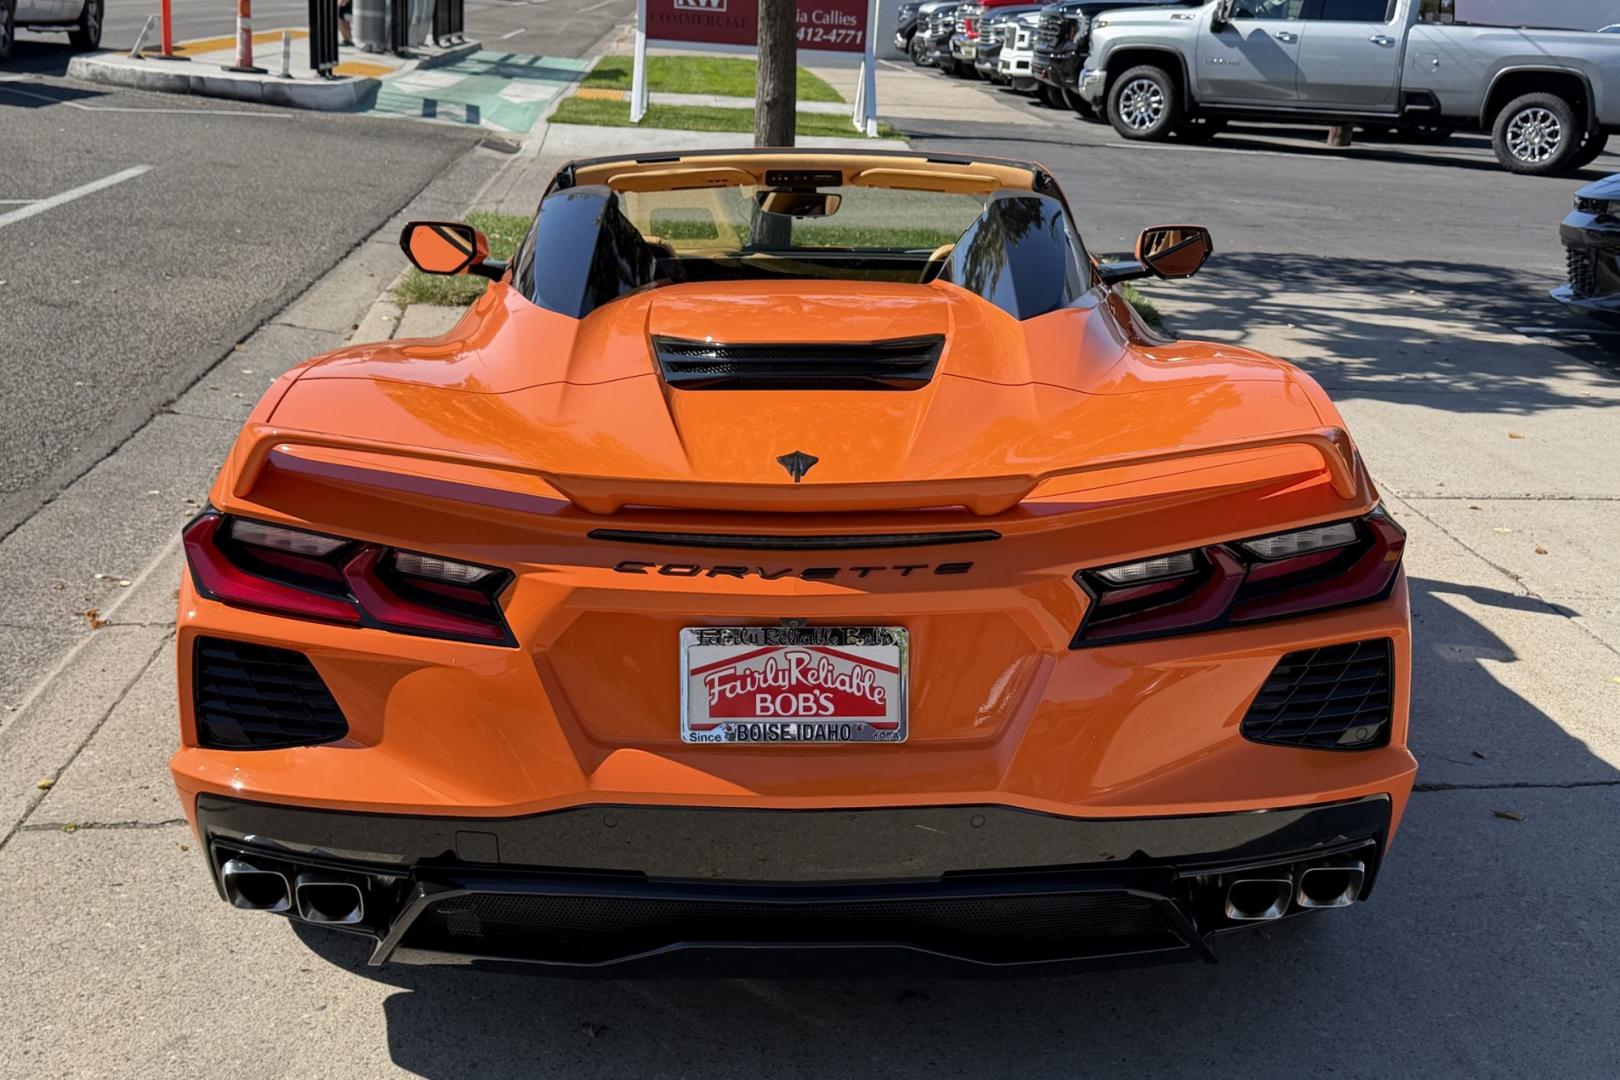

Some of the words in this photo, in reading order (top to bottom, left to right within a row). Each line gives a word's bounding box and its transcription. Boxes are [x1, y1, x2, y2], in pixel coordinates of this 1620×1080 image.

[650, 11, 748, 29] COMMERCIAL
[811, 9, 857, 26] Callies
[612, 560, 975, 580] CORVETTE
[704, 657, 789, 705] Fairly
[784, 651, 887, 704] Reliable
[755, 690, 835, 716] BOB'S
[689, 732, 722, 742] Since
[737, 724, 791, 742] BOISE
[796, 724, 852, 742] IDAHO
